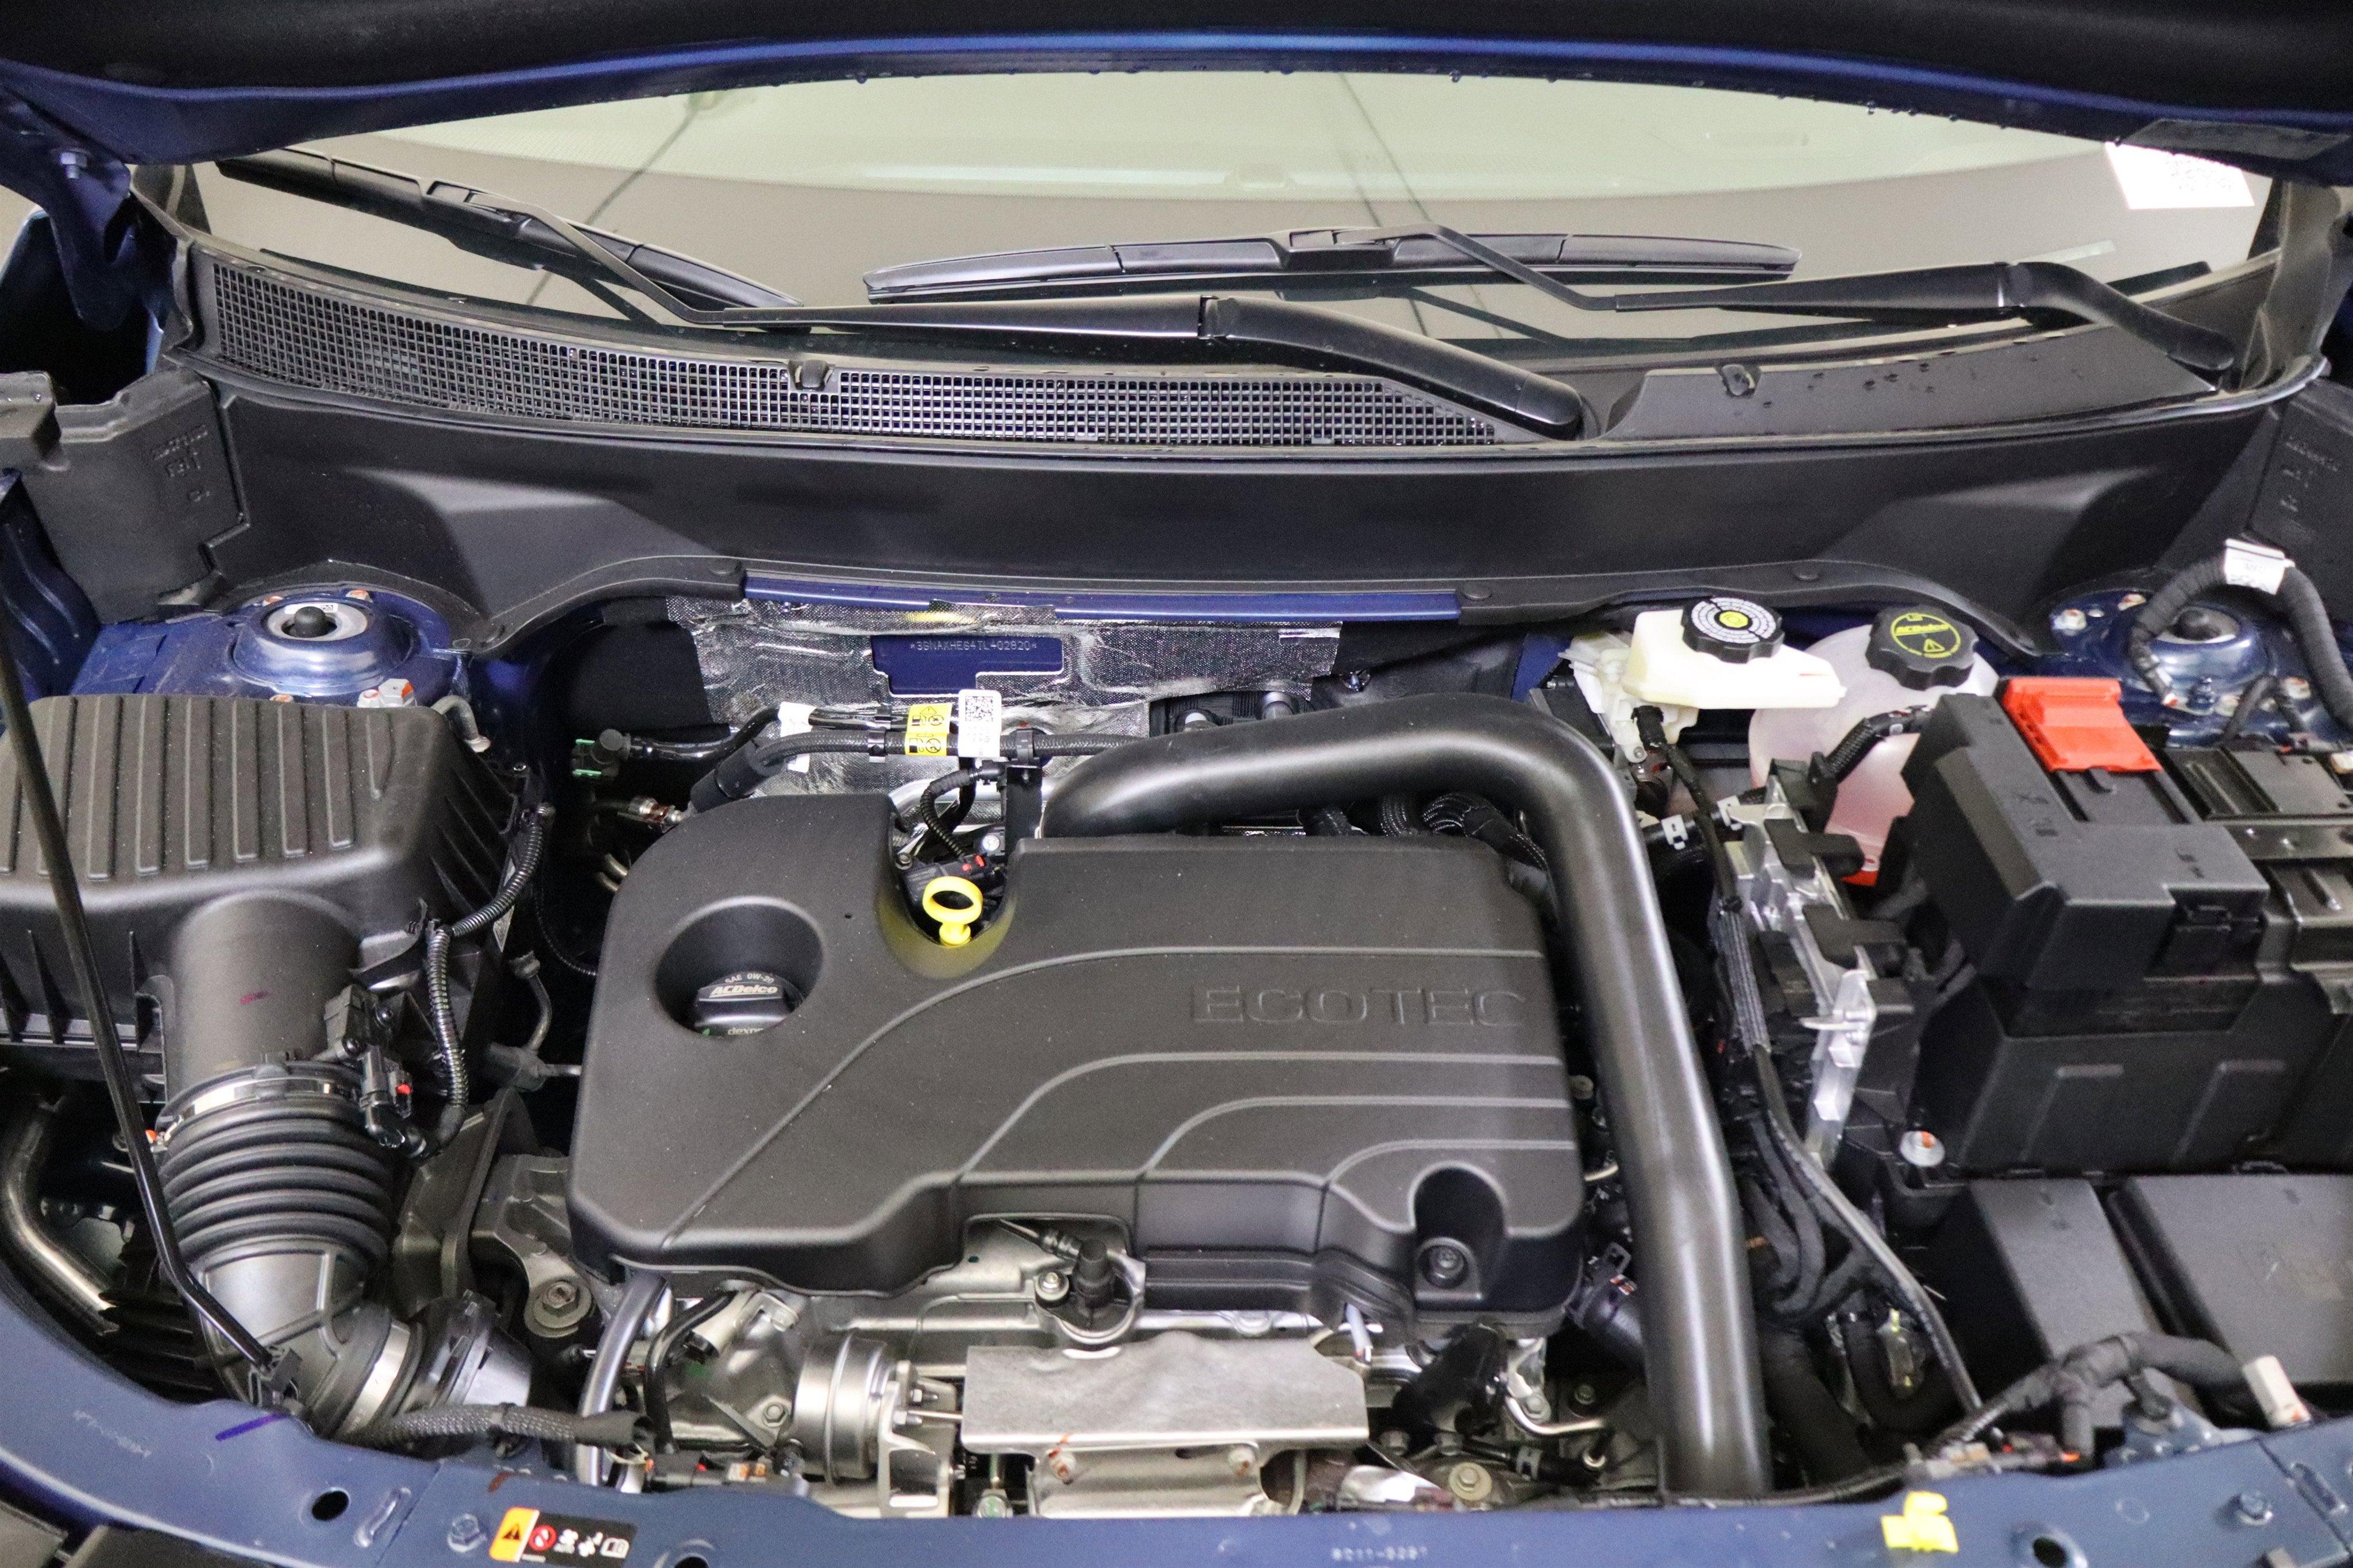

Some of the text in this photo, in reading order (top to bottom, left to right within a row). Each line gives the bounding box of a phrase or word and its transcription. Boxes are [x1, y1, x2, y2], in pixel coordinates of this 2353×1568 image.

[724, 972, 775, 984] SAE 0W-20
[710, 984, 778, 997] ACDelco
[1191, 986, 1526, 1027] ECOTEC
